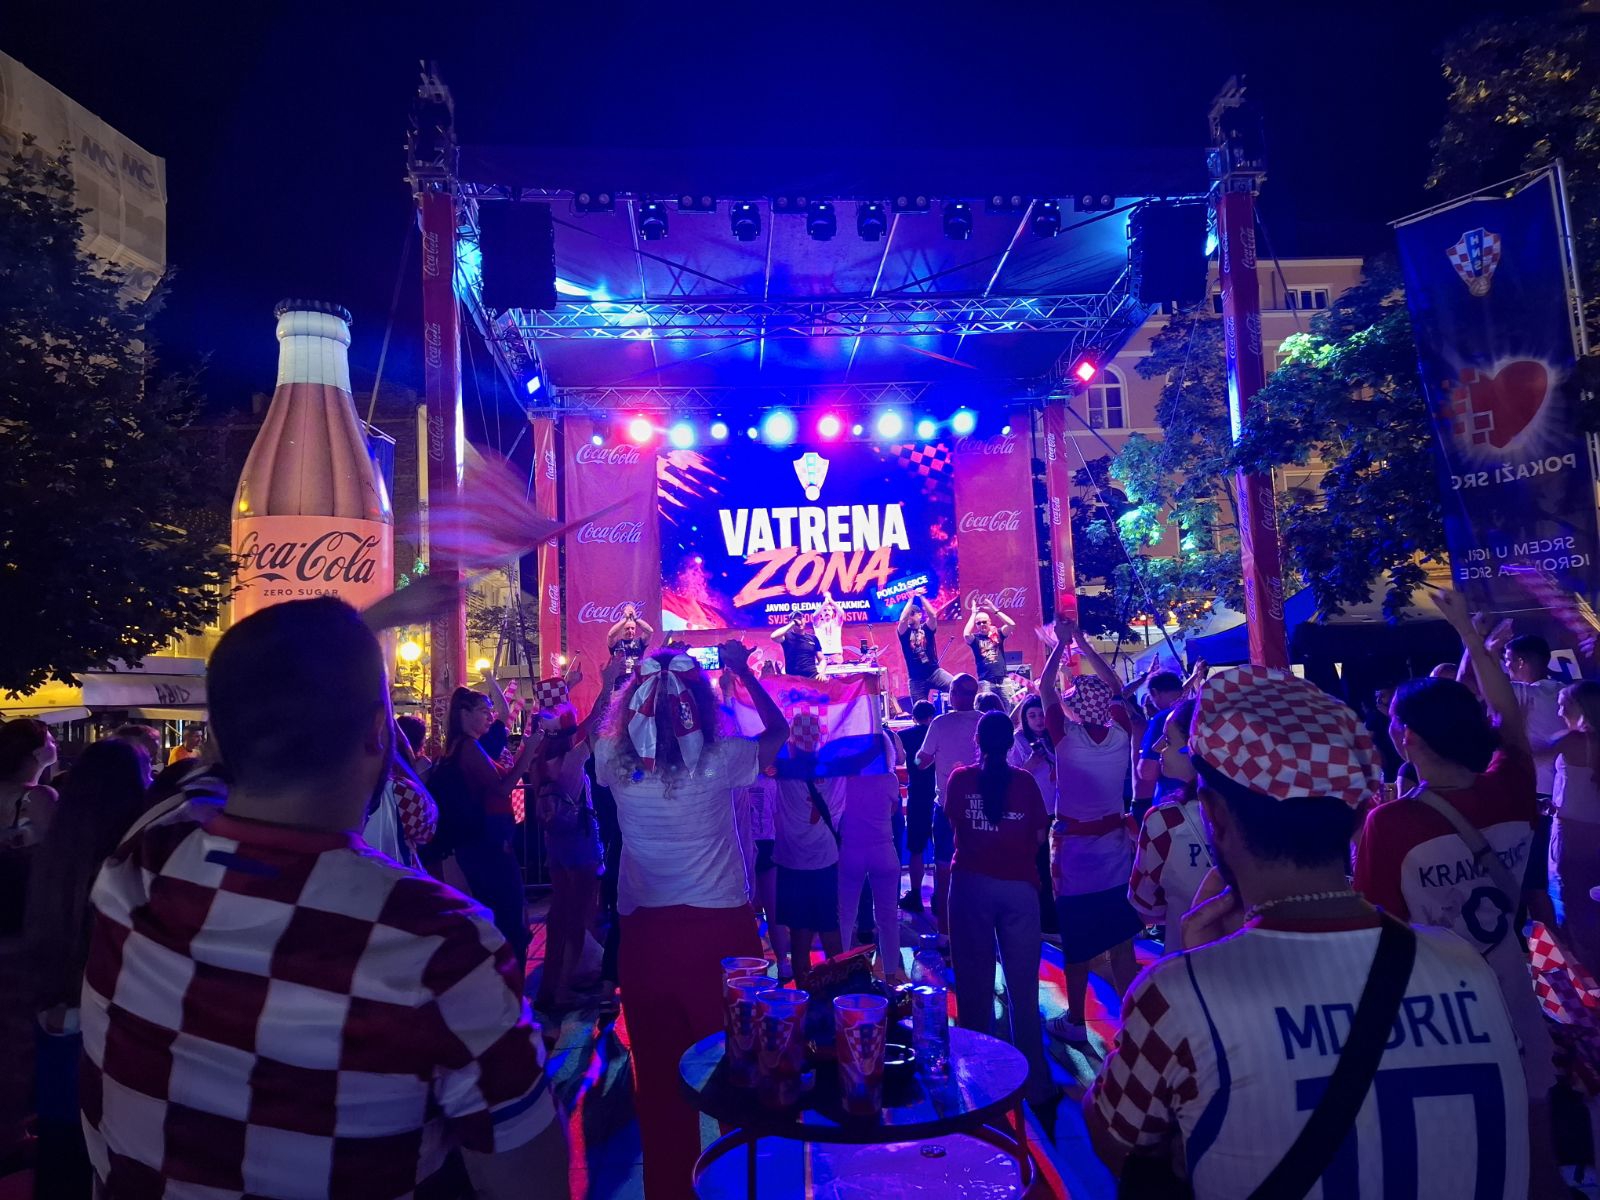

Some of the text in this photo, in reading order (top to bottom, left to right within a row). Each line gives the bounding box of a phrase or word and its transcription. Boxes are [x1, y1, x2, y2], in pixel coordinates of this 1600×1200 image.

[423, 231, 440, 277] Coca-Cola
[425, 321, 442, 369] Coca-Cola
[427, 414, 445, 463] Coca-Cola
[576, 443, 641, 465] Coca-Cola
[955, 433, 1016, 456] Coca-Cola
[718, 503, 910, 557] VATRENA
[959, 510, 1022, 533] Coca-Cola
[1258, 487, 1277, 531] Coca-Cola
[577, 521, 645, 544] Coca-Cola
[236, 531, 381, 584] Coca-Cola
[733, 546, 898, 608] ZONA
[765, 600, 871, 613] JAVNO GLEDAN TAKMICA
[876, 582, 906, 600] POKAŽI
[907, 575, 929, 590] SRCE
[964, 586, 1029, 610] Coca-Cola
[1267, 576, 1285, 621] Coca-Cola
